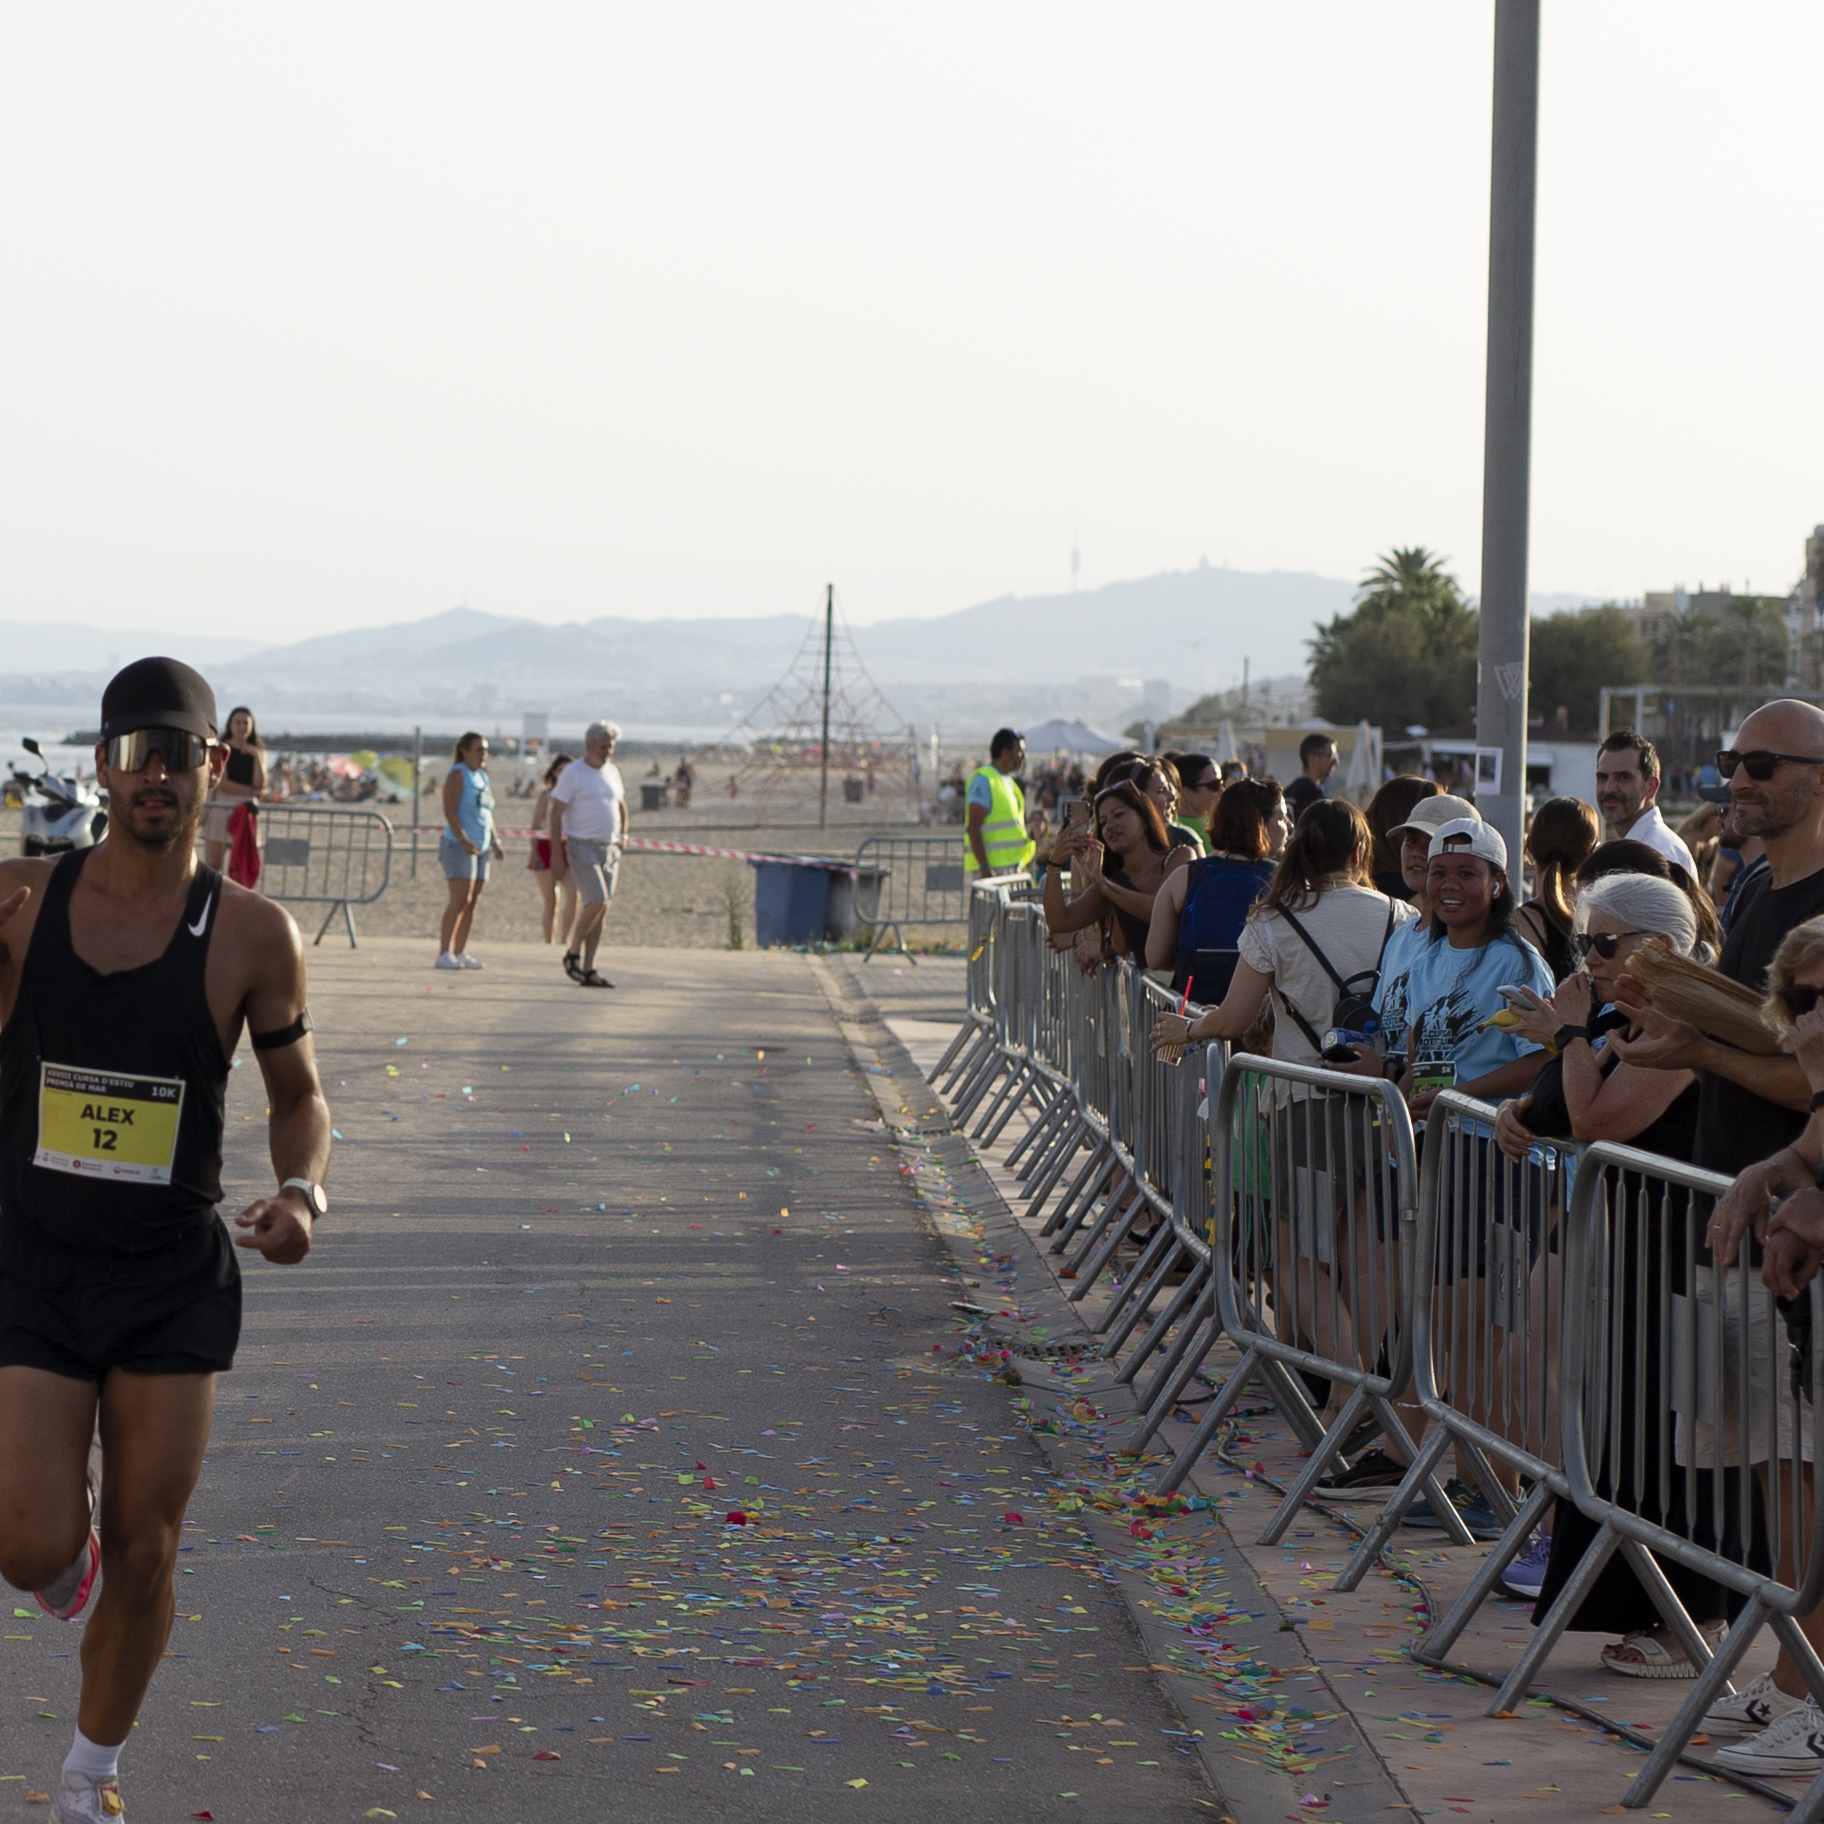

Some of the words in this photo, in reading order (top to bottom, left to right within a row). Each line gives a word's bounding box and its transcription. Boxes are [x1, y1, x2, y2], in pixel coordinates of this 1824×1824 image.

[46, 1077, 74, 1089] PREMIÀ
[76, 1082, 86, 1090] DE
[88, 1084, 107, 1093] MAR
[73, 1073, 100, 1084] CURSA
[101, 1077, 135, 1089] D'ESTIU
[151, 1086, 177, 1099] 10K
[80, 1104, 136, 1126] ALEX
[92, 1128, 119, 1151] 12
